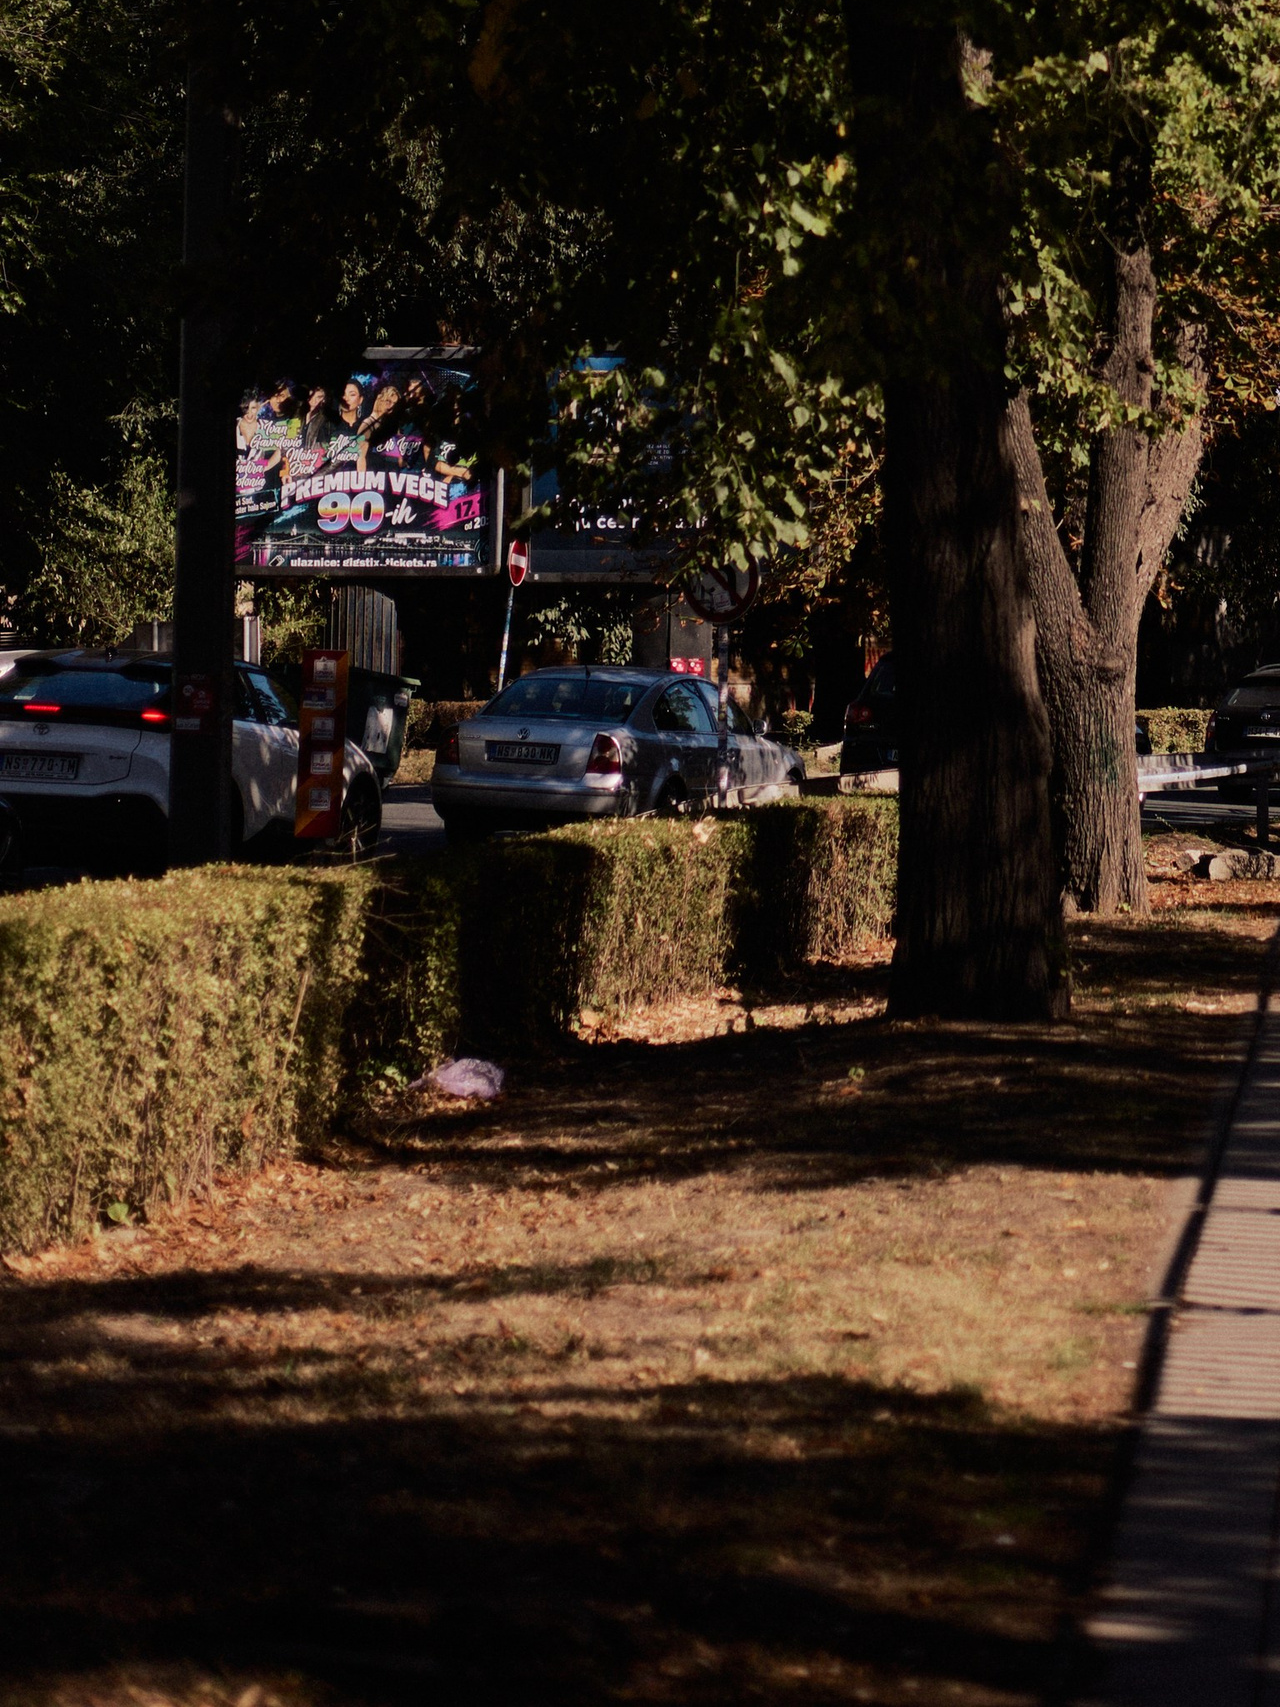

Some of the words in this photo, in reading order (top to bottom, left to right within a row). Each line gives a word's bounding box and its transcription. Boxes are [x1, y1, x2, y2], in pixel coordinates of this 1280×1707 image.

[286, 448, 319, 462] Moby
[236, 459, 264, 475] ndira
[290, 460, 316, 475] Dick
[280, 470, 386, 508] PREMIUM
[389, 469, 449, 508] VEČE
[317, 492, 416, 534] 90-ih
[464, 521, 473, 531] od
[290, 557, 340, 567] ulaznice:
[4, 756, 21, 770] NS
